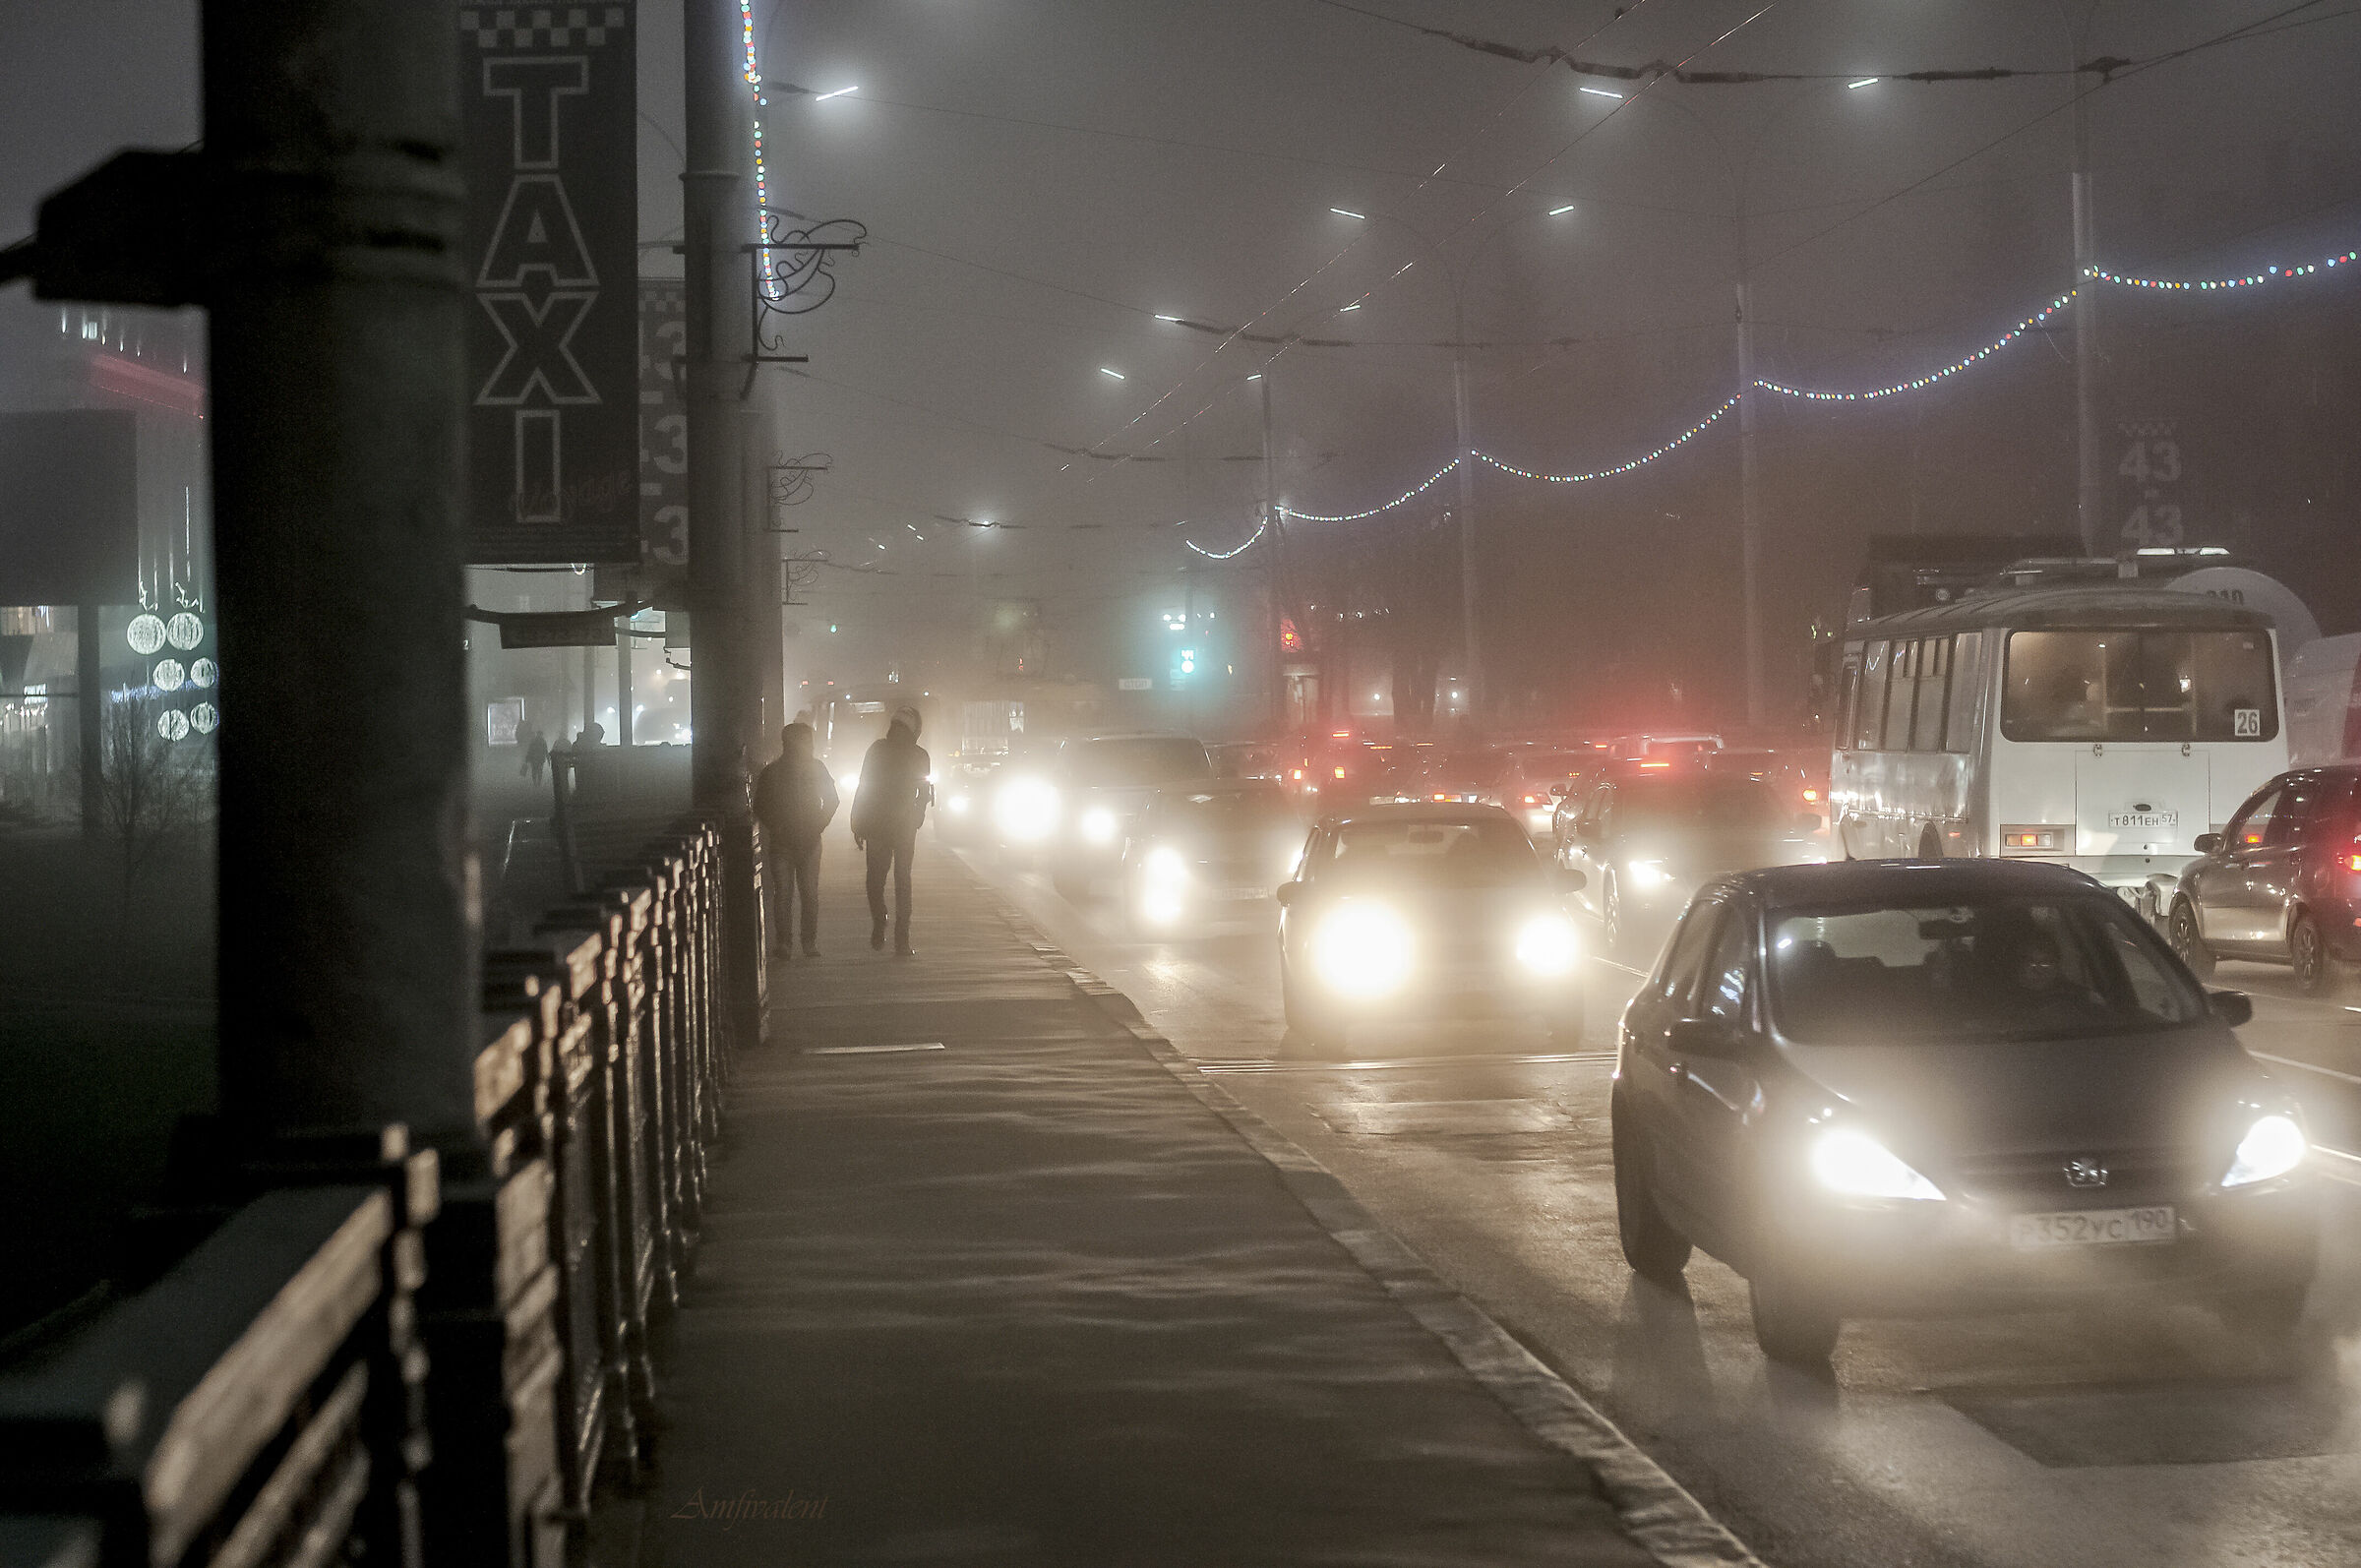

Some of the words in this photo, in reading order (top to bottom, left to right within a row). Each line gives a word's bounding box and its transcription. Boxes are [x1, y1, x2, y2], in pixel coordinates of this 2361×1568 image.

[472, 55, 602, 522] TAXI
[2118, 443, 2182, 481] 43
[2121, 506, 2184, 545] 43
[2237, 711, 2258, 734] 26
